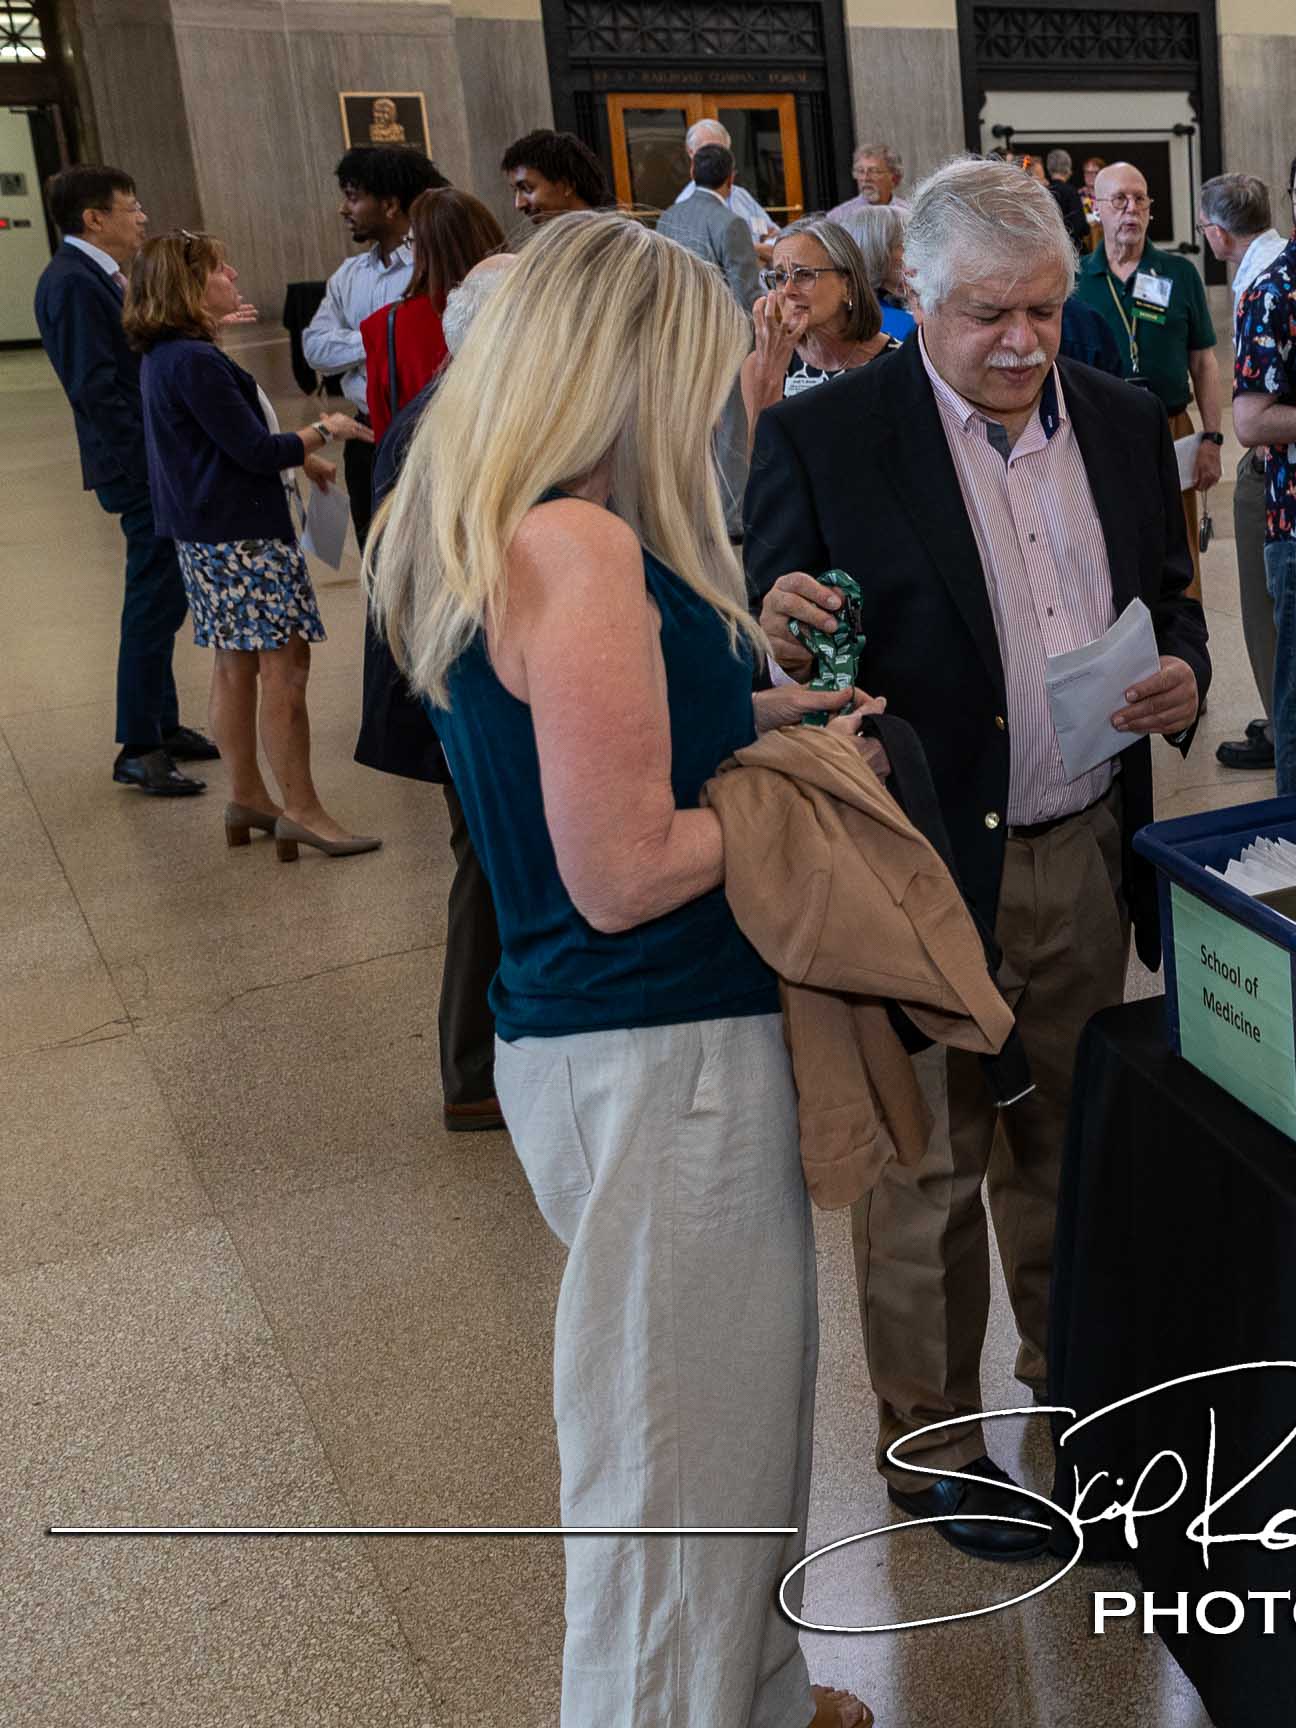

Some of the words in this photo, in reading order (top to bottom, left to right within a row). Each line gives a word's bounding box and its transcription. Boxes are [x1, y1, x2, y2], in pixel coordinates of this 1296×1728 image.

[1200, 944, 1240, 988] School
[1245, 977, 1258, 998] of
[1202, 987, 1261, 1043] Medicine
